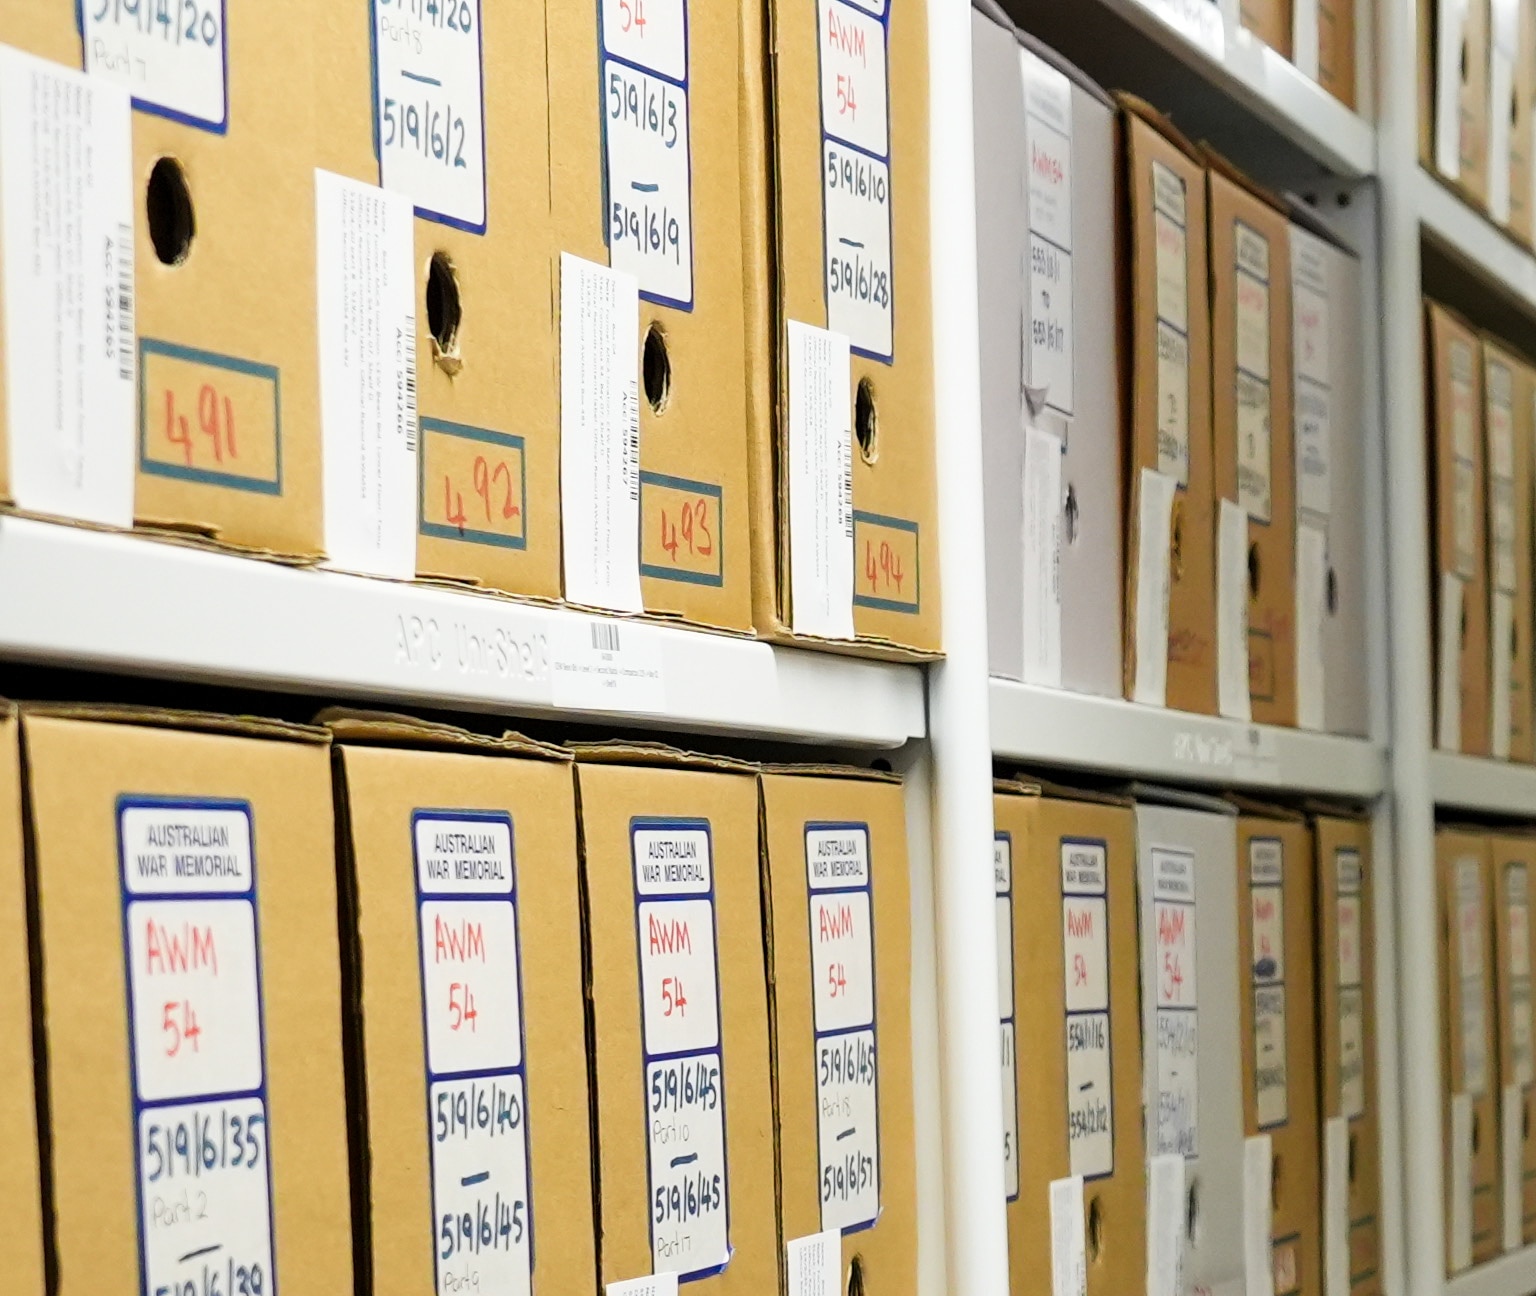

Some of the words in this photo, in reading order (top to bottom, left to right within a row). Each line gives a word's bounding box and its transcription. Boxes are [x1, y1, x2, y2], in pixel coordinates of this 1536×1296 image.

[828, 7, 867, 68] AWM
[610, 72, 677, 148] 519/6/3
[836, 73, 857, 121] 54
[383, 98, 467, 169] 519/6/2
[828, 151, 887, 204] 519/6/10
[612, 204, 680, 265] 519/6/9
[830, 252, 889, 310] 519/6/28
[164, 383, 238, 466] 491
[444, 455, 520, 538] 492
[661, 498, 711, 562] 493
[865, 539, 903, 593] 494
[148, 824, 230, 849] AUSTRALIAN
[434, 833, 495, 855] AUSTRALIAN
[647, 840, 697, 861] AUSTRALIAN
[817, 839, 857, 858] AUSTRALIAN
[138, 853, 168, 878] WAR
[175, 853, 242, 878] MEMORIAL
[427, 859, 450, 880] WAR
[455, 859, 505, 881] MEMORIAL
[642, 864, 661, 883] WAR
[664, 863, 704, 884] MEMORIAL
[813, 860, 830, 877] WAR
[832, 859, 864, 877] MEMORIAL
[145, 916, 217, 976] AWM
[435, 914, 486, 964] AWM
[649, 912, 692, 956] AWM
[819, 904, 854, 943] AWM
[449, 982, 477, 1033] 54
[662, 976, 687, 1017] 54
[829, 964, 846, 998] 54
[162, 1001, 200, 1058] 54
[651, 1061, 719, 1114] 519/6/45
[820, 1036, 875, 1087] 519/6/45
[147, 1111, 264, 1184] 519/6/35
[655, 1172, 721, 1225] 519/6/45
[822, 1150, 873, 1203] 519/6/57
[441, 1192, 524, 1260] 519/6/45
